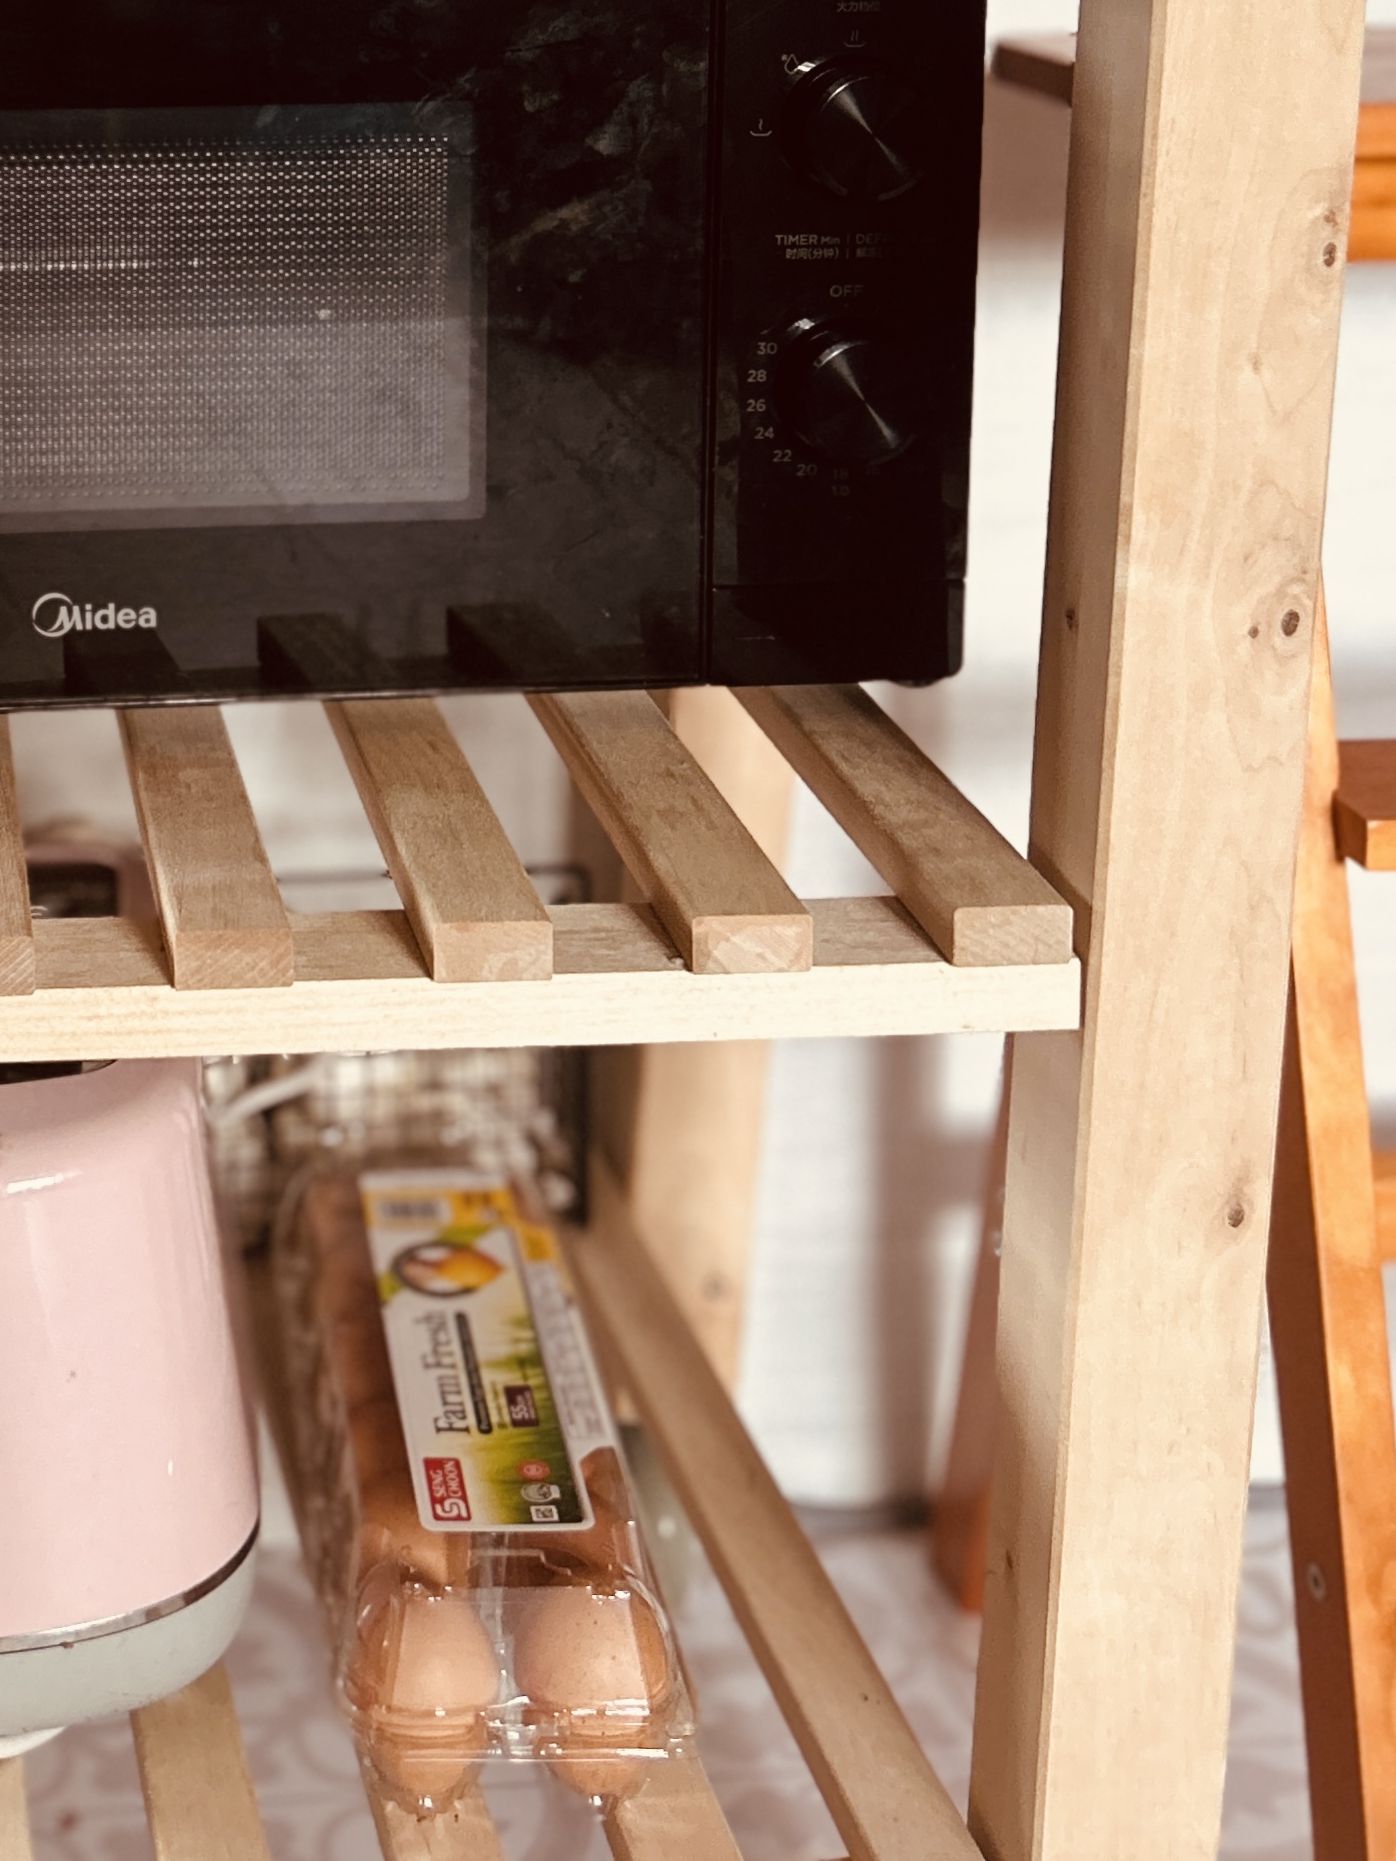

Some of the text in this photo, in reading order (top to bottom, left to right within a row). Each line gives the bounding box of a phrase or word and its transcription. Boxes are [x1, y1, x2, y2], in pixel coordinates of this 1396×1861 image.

[775, 234, 818, 246] TIMER
[829, 284, 864, 298] OFF
[756, 342, 778, 355] 30
[747, 369, 767, 383] 28
[746, 399, 767, 412] 26
[754, 426, 775, 439] 24
[772, 449, 792, 463] 22
[796, 463, 818, 477] 20
[34, 594, 158, 637] Midea
[413, 1311, 471, 1435] Farm Fresh
[429, 1468, 445, 1499] SENG
[443, 1460, 463, 1499] CHOON
